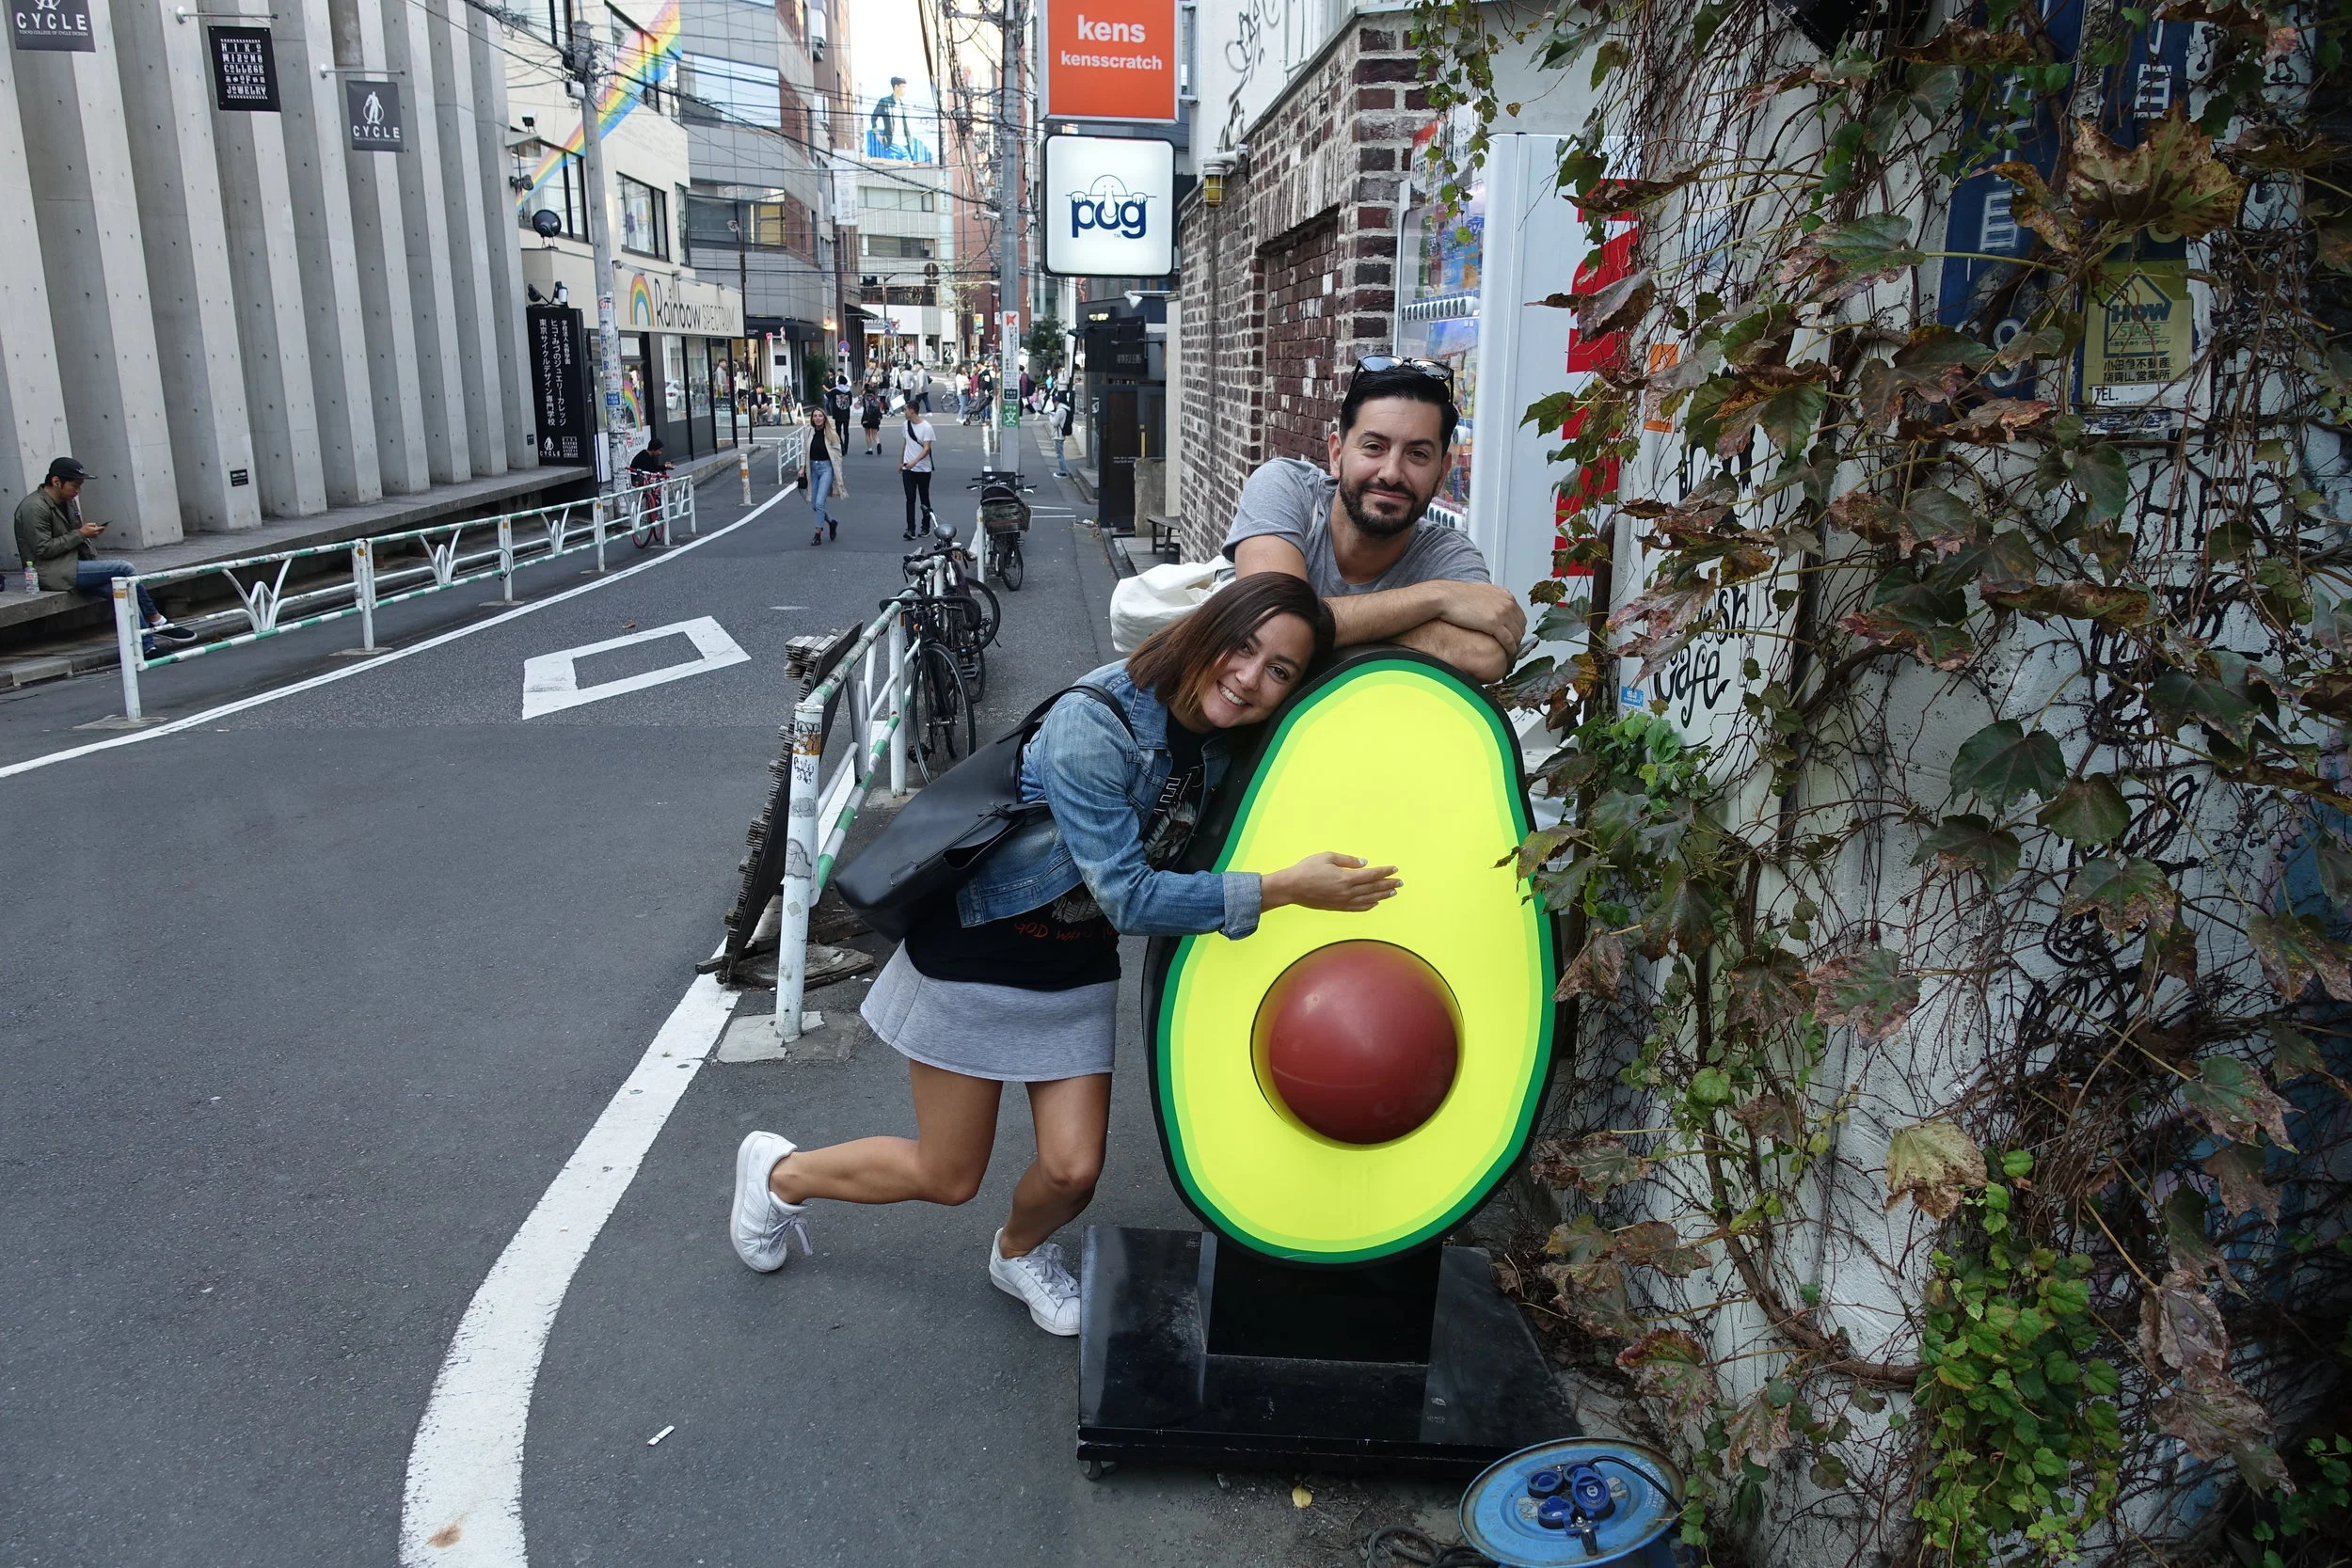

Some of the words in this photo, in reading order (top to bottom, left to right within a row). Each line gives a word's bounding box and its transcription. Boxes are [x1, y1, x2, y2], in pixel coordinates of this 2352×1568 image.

[16, 12, 87, 30] CYCLE
[1077, 14, 1146, 43] kens
[221, 42, 262, 53] HIKO
[222, 54, 263, 63] MIZUNO
[1060, 50, 1163, 71] kensscratch
[224, 64, 264, 73] COLLEGE
[353, 125, 401, 138] CYCLE
[654, 277, 701, 330] Rainbow
[702, 304, 736, 332] SPECTRUM
[2111, 303, 2172, 323] HOW
